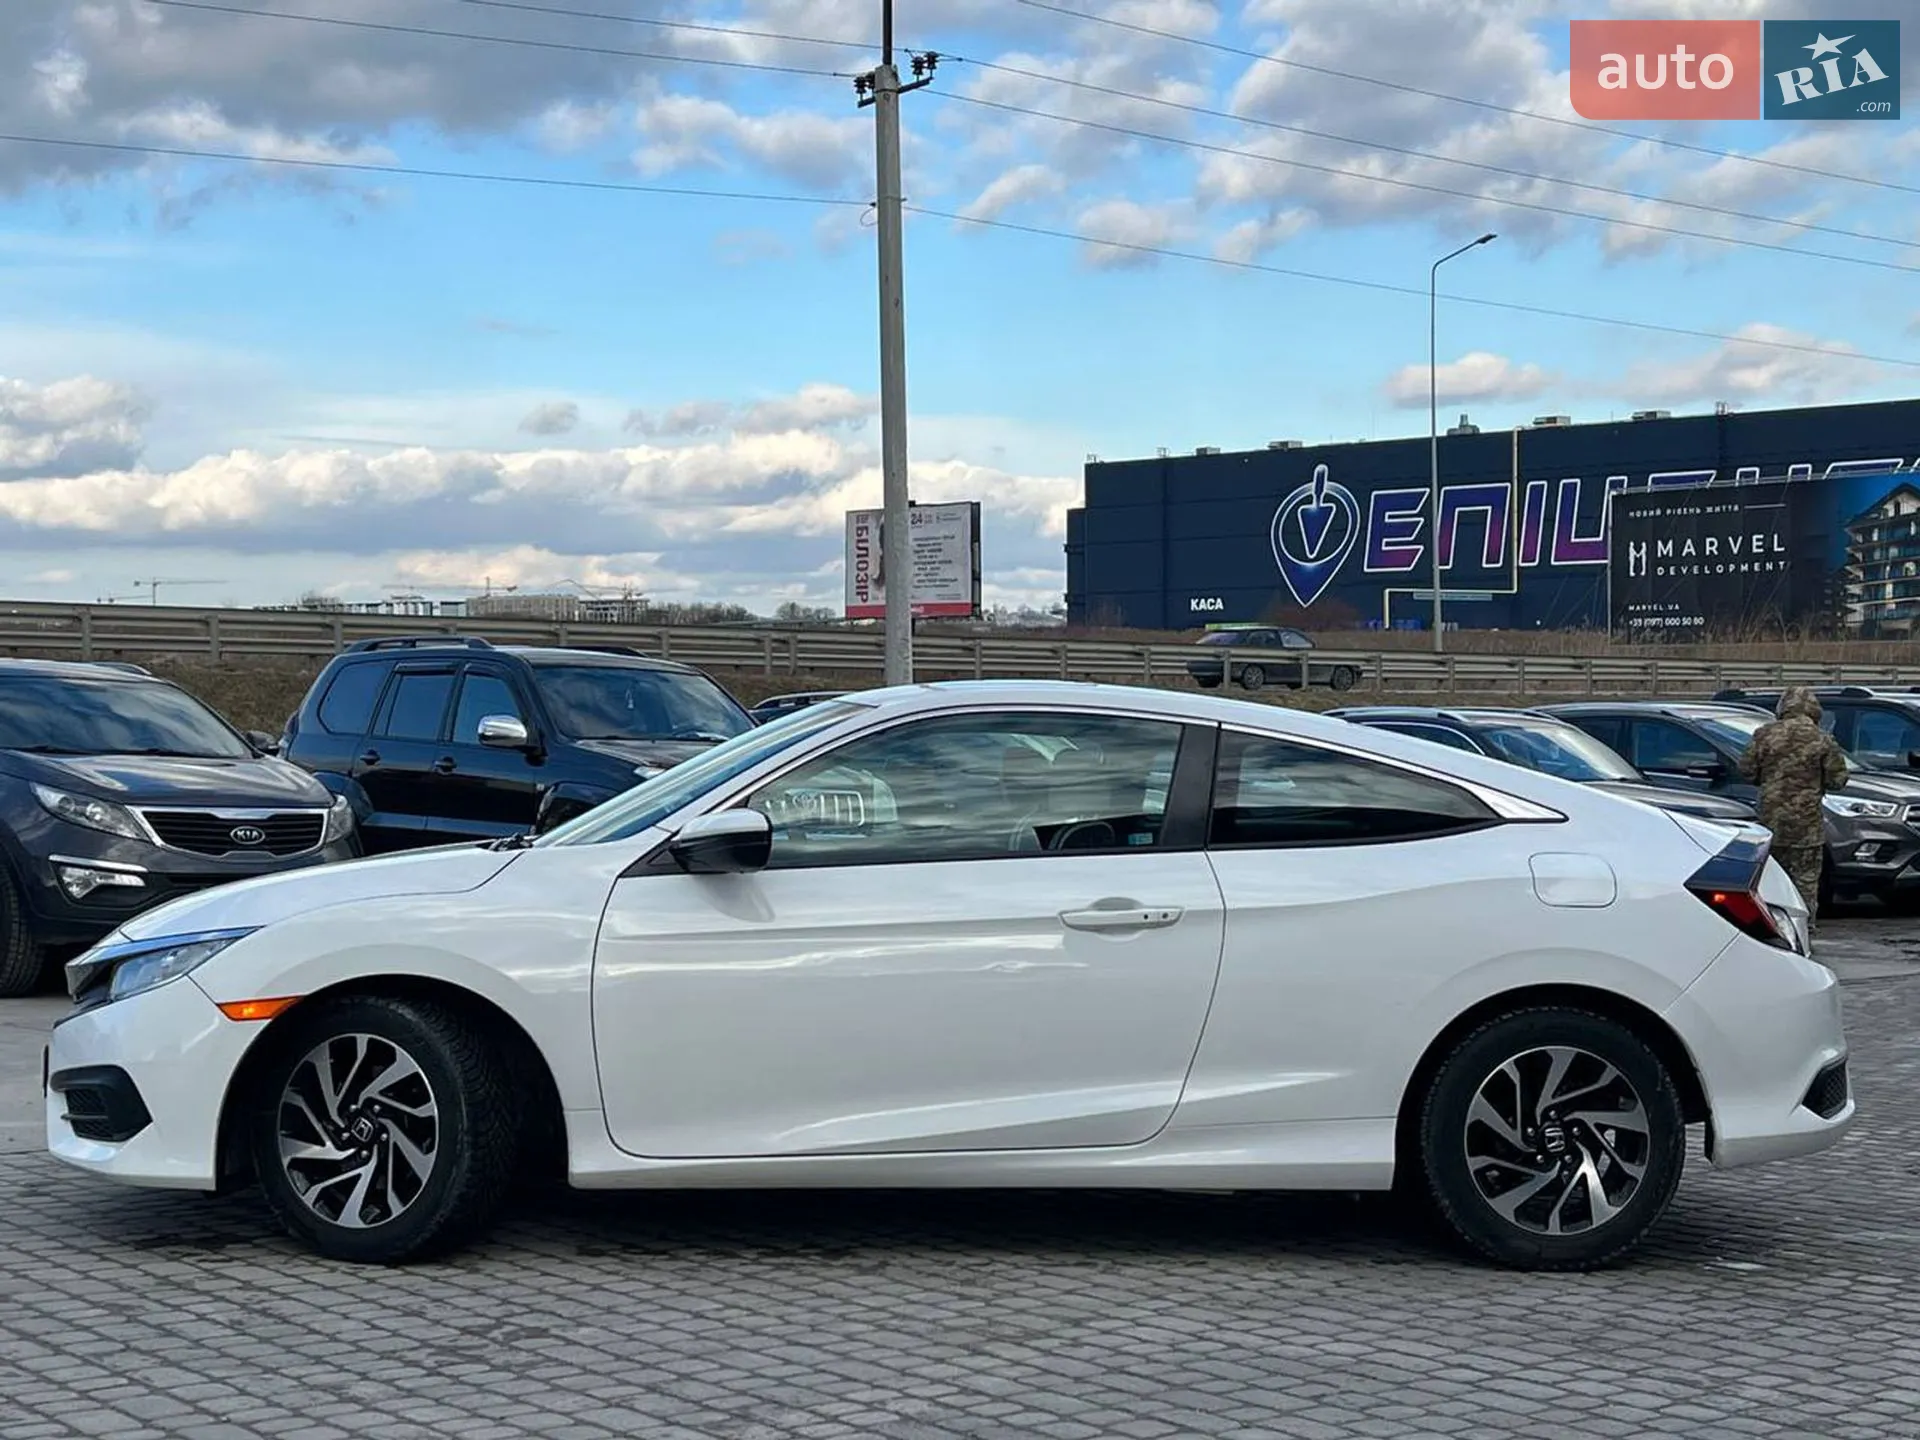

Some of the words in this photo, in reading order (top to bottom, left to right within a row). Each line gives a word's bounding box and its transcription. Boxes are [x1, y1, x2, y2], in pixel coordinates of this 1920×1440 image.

[1656, 533, 1786, 558] MARVEL
[855, 525, 869, 603] БІЛОЗІР
[1656, 560, 1786, 576] DEVELOPMENT
[1190, 597, 1225, 611] КАСА
[236, 829, 261, 841] KIA
